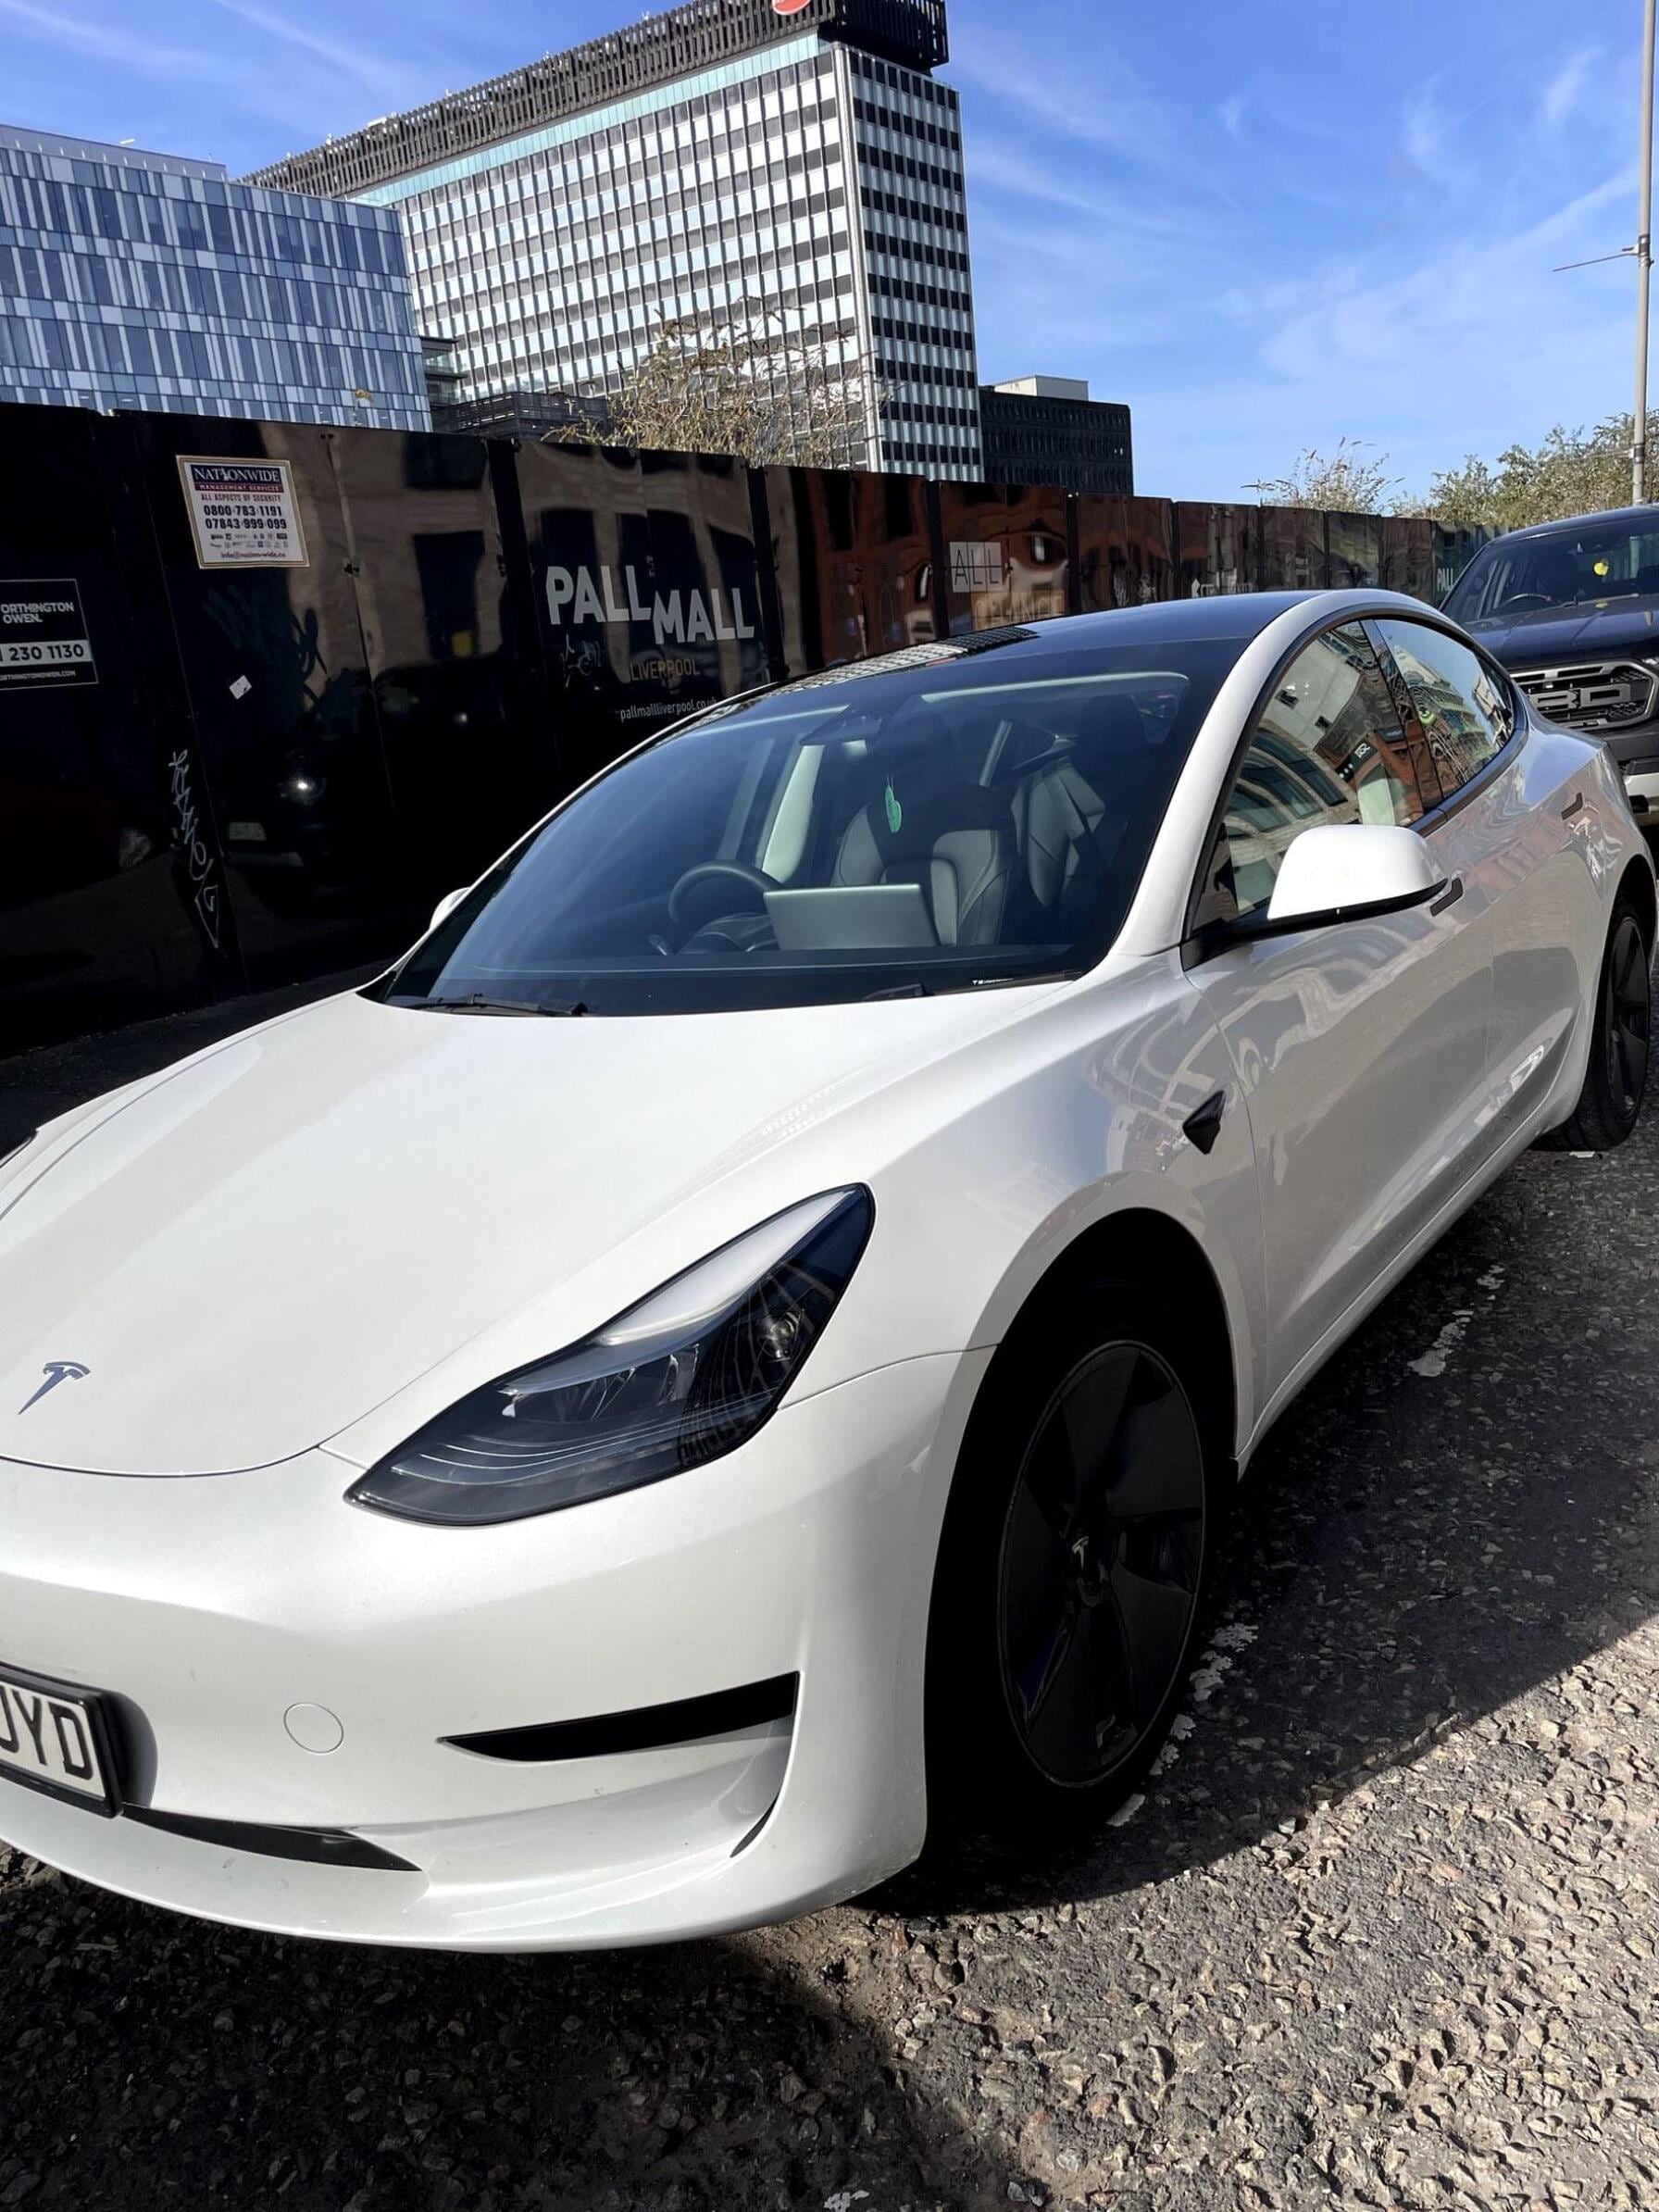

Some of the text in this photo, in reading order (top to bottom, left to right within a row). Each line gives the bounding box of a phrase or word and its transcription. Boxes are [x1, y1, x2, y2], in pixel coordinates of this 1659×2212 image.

[193, 468, 280, 481] NATIONWIDE
[204, 505, 282, 517] 0800 783 1191
[205, 519, 287, 530] 07843 999 099
[954, 549, 1000, 586] ALL
[546, 566, 652, 624] PALL
[653, 588, 755, 644] MALL
[8, 646, 42, 662] 230
[47, 644, 84, 659] 1130
[630, 657, 701, 681] LIVERPOOL
